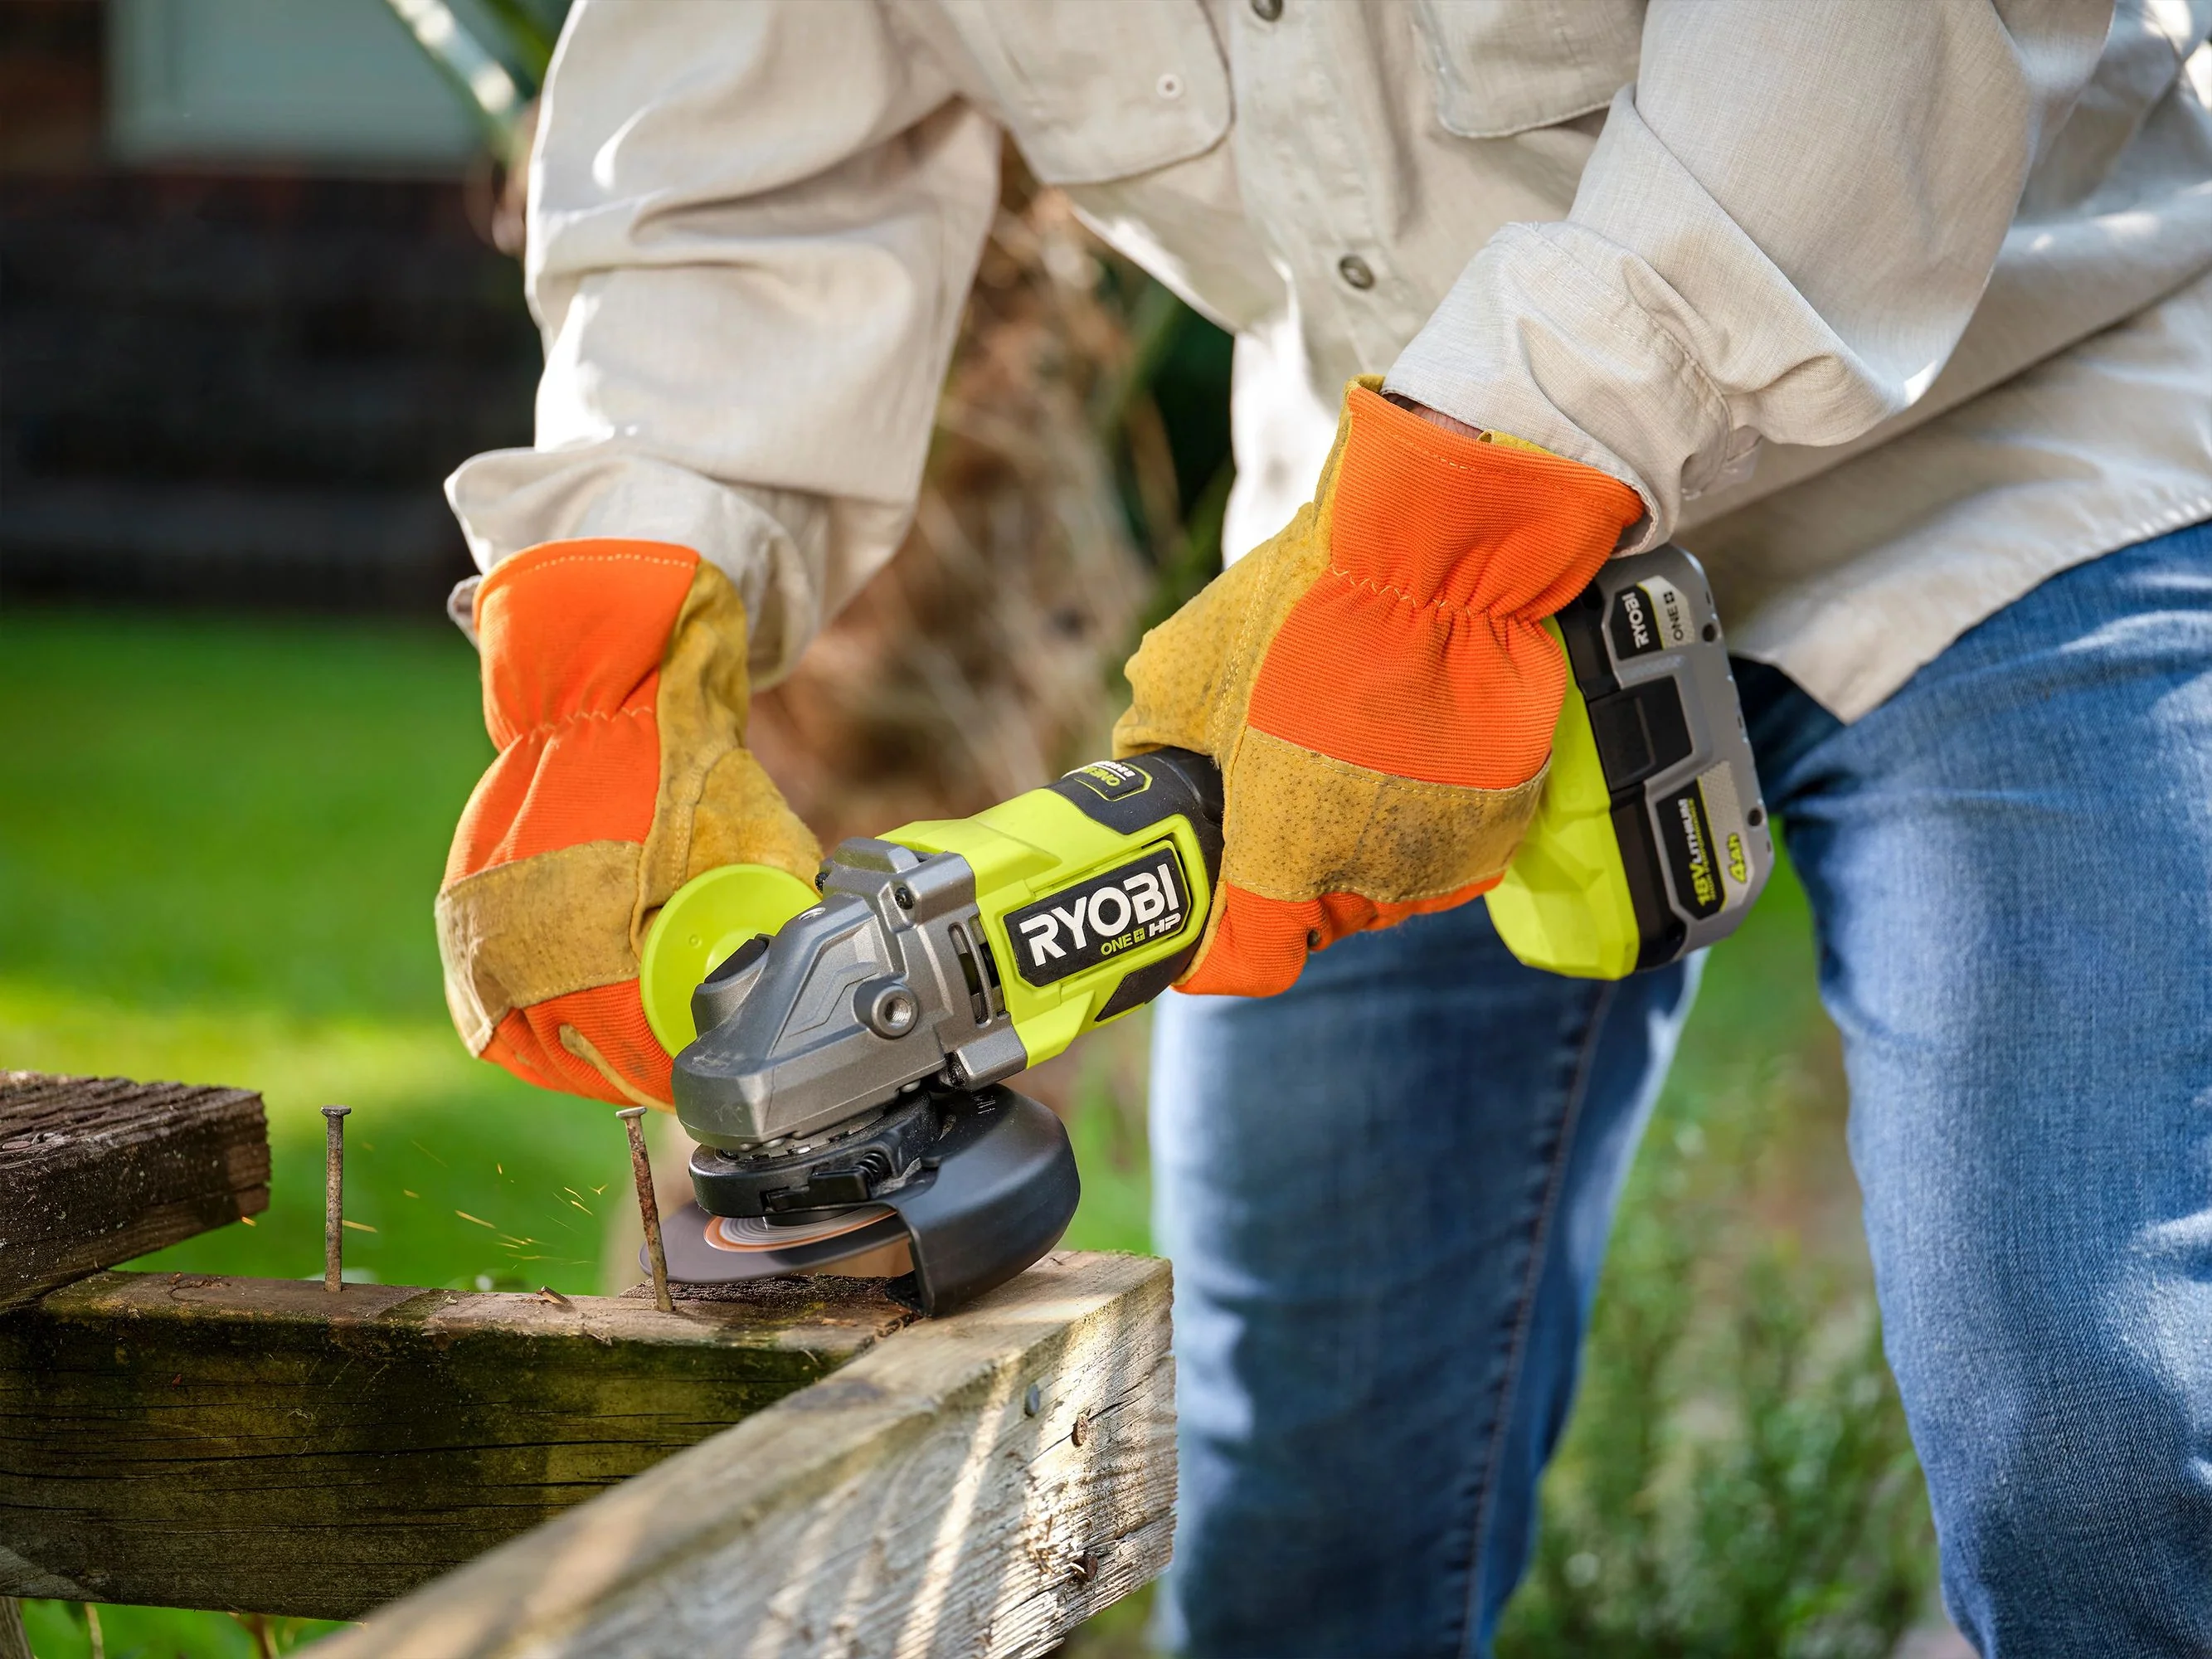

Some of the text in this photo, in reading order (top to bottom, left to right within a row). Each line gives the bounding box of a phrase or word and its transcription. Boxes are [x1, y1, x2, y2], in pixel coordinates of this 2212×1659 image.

[1621, 592, 1649, 649] RYOBI
[1018, 864, 1179, 967] RYOBI
[1149, 912, 1181, 937] HP
